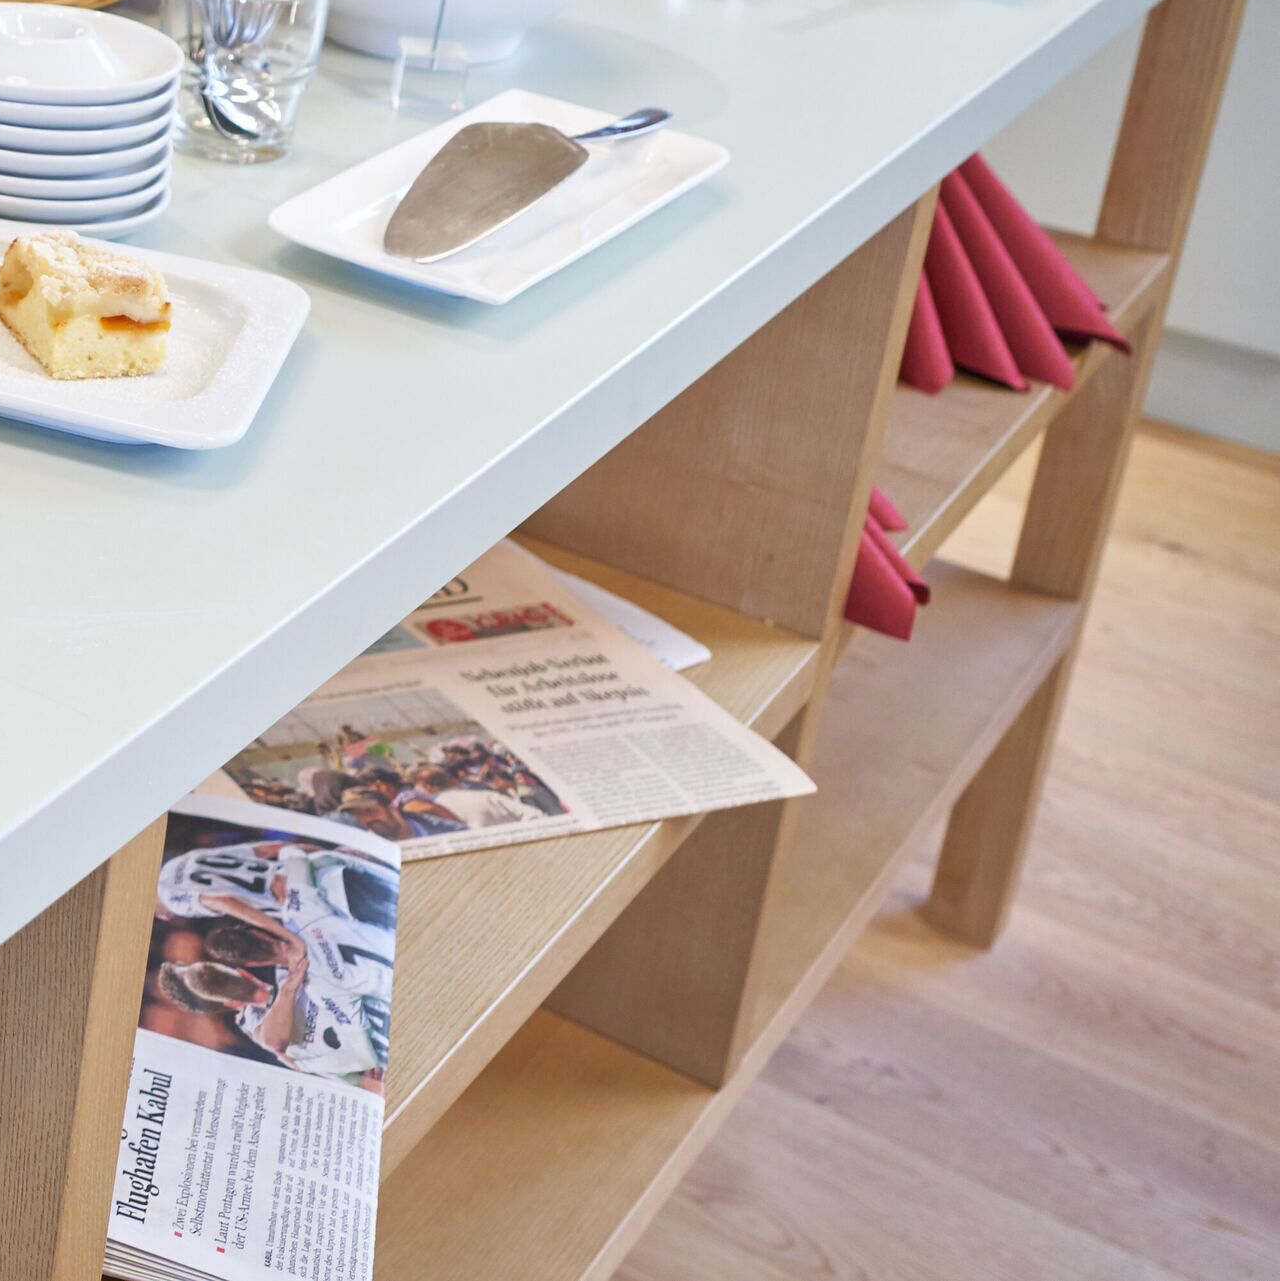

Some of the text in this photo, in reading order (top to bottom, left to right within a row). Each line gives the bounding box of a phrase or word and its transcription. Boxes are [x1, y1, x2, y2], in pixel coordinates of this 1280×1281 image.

[136, 1068, 172, 1126] Kabul
[247, 1112, 265, 1146] Anschlag
[184, 1139, 198, 1153] bei
[189, 1078, 227, 1237] Selbstmordattentat in Menschenmenge
[214, 1083, 252, 1244] Laut Pentagon wurden zwölf Mitglieder
[244, 1149, 259, 1169] dem
[116, 1127, 160, 1224] Flughafen
[176, 1153, 198, 1208] Explosionen
[240, 1169, 256, 1183] bei
[171, 1207, 187, 1230] Zwei
[234, 1184, 253, 1231] US-Armee
[231, 1232, 246, 1250] der
[300, 1237, 312, 1254] Lage
[263, 1248, 273, 1268] KABUL.
[274, 1261, 283, 1272] der
